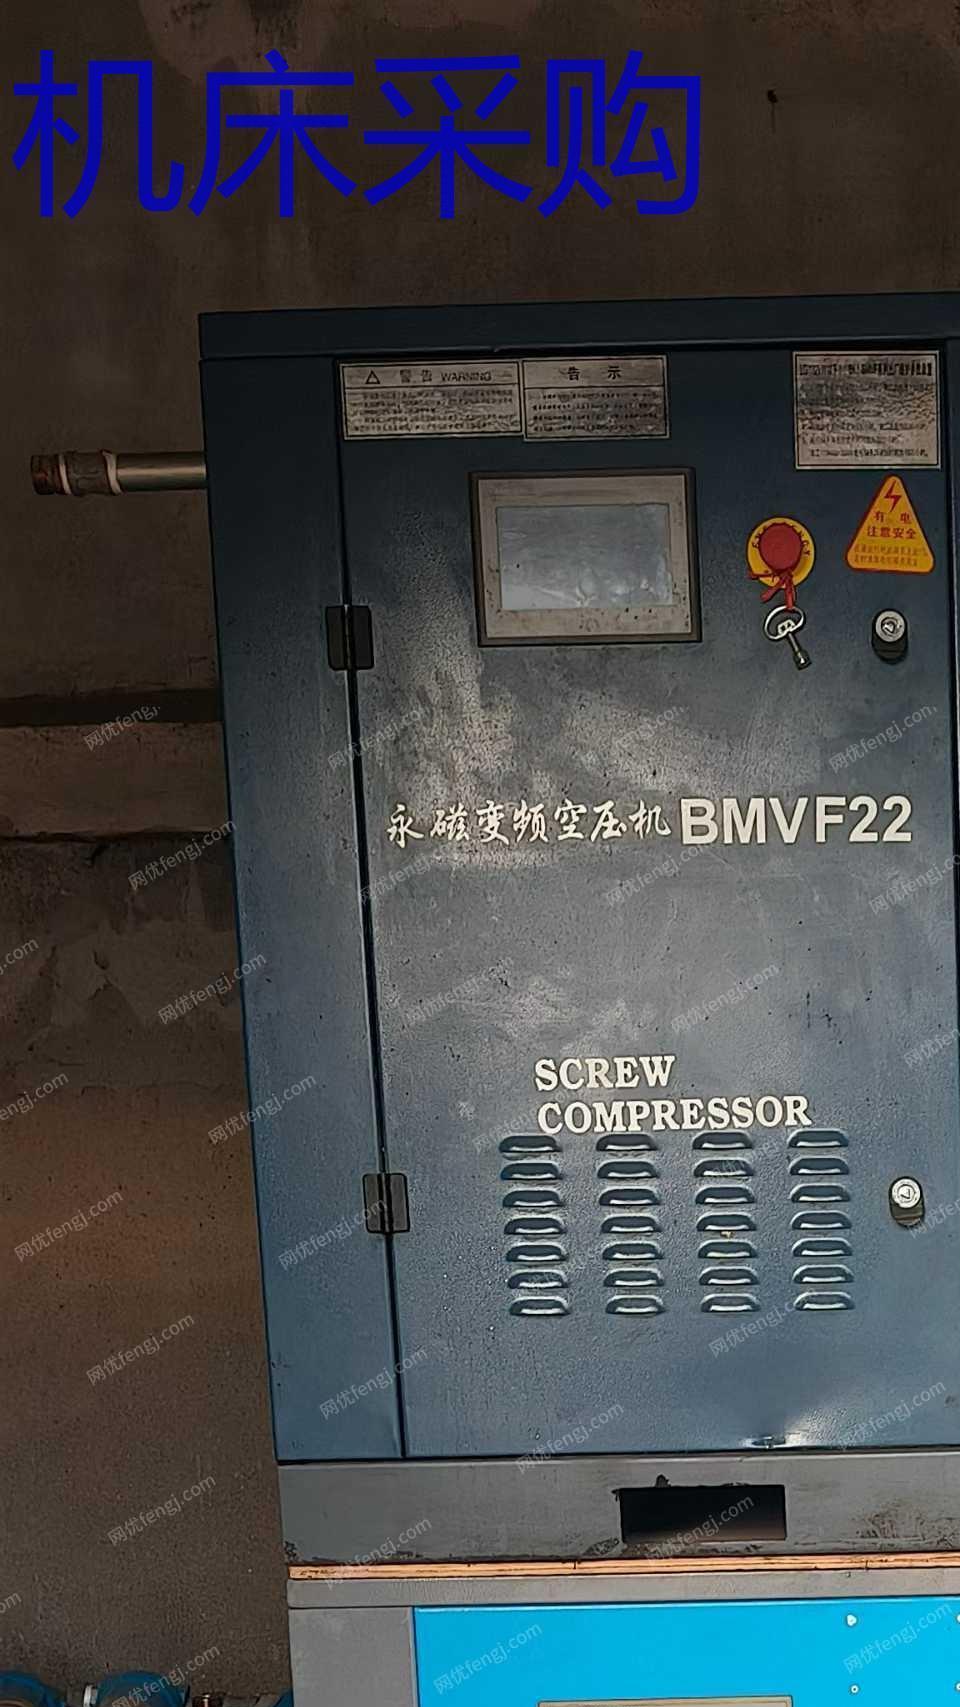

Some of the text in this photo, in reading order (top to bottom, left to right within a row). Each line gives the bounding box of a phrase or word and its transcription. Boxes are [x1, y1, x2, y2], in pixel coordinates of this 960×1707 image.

[867, 526, 917, 539] 注意安全
[386, 795, 913, 849] 永磁变频空压机 BMVF22
[534, 1055, 676, 1092] SCREW
[537, 1095, 812, 1134] COMPRESSOR
